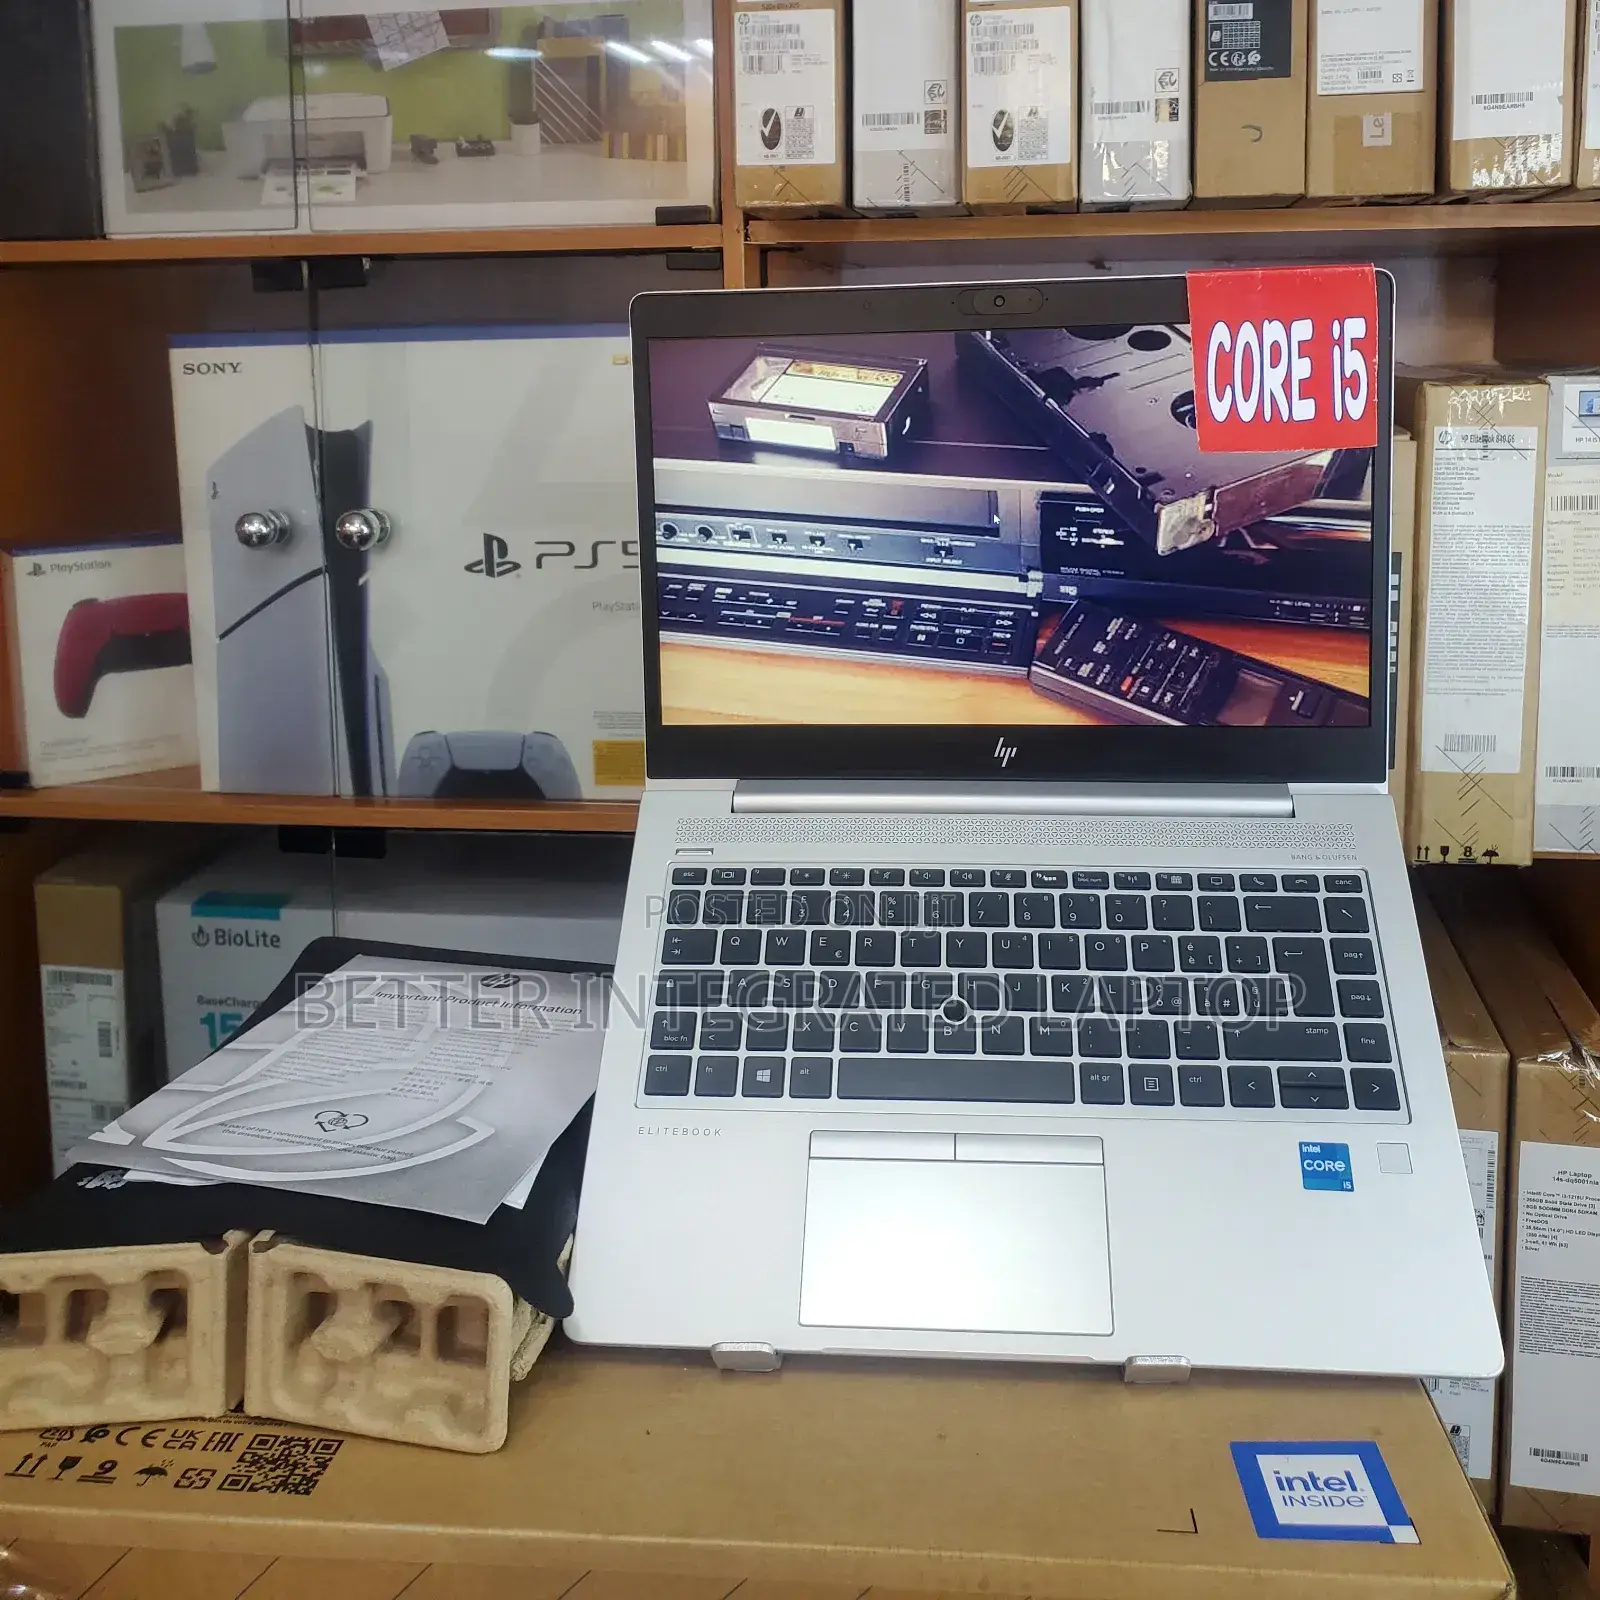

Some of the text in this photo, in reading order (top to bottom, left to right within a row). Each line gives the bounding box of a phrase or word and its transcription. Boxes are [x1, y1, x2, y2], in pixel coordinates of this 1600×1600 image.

[182, 361, 242, 376] SONY
[1206, 316, 1370, 423] CORE i5
[50, 560, 112, 574] PlayStation
[214, 928, 281, 948] BioLite
[374, 991, 582, 1015] Important Product Information
[1350, 994, 1365, 1002] pag
[1306, 1027, 1329, 1036] stamp
[638, 1126, 721, 1136] ELITEBOOK
[1302, 1144, 1321, 1154] intel
[1569, 1171, 1592, 1179] Laptop
[1343, 1181, 1352, 1189] i5
[170, 1428, 205, 1440] UK
[163, 1440, 197, 1450] CA
[1273, 1470, 1358, 1492] intel
